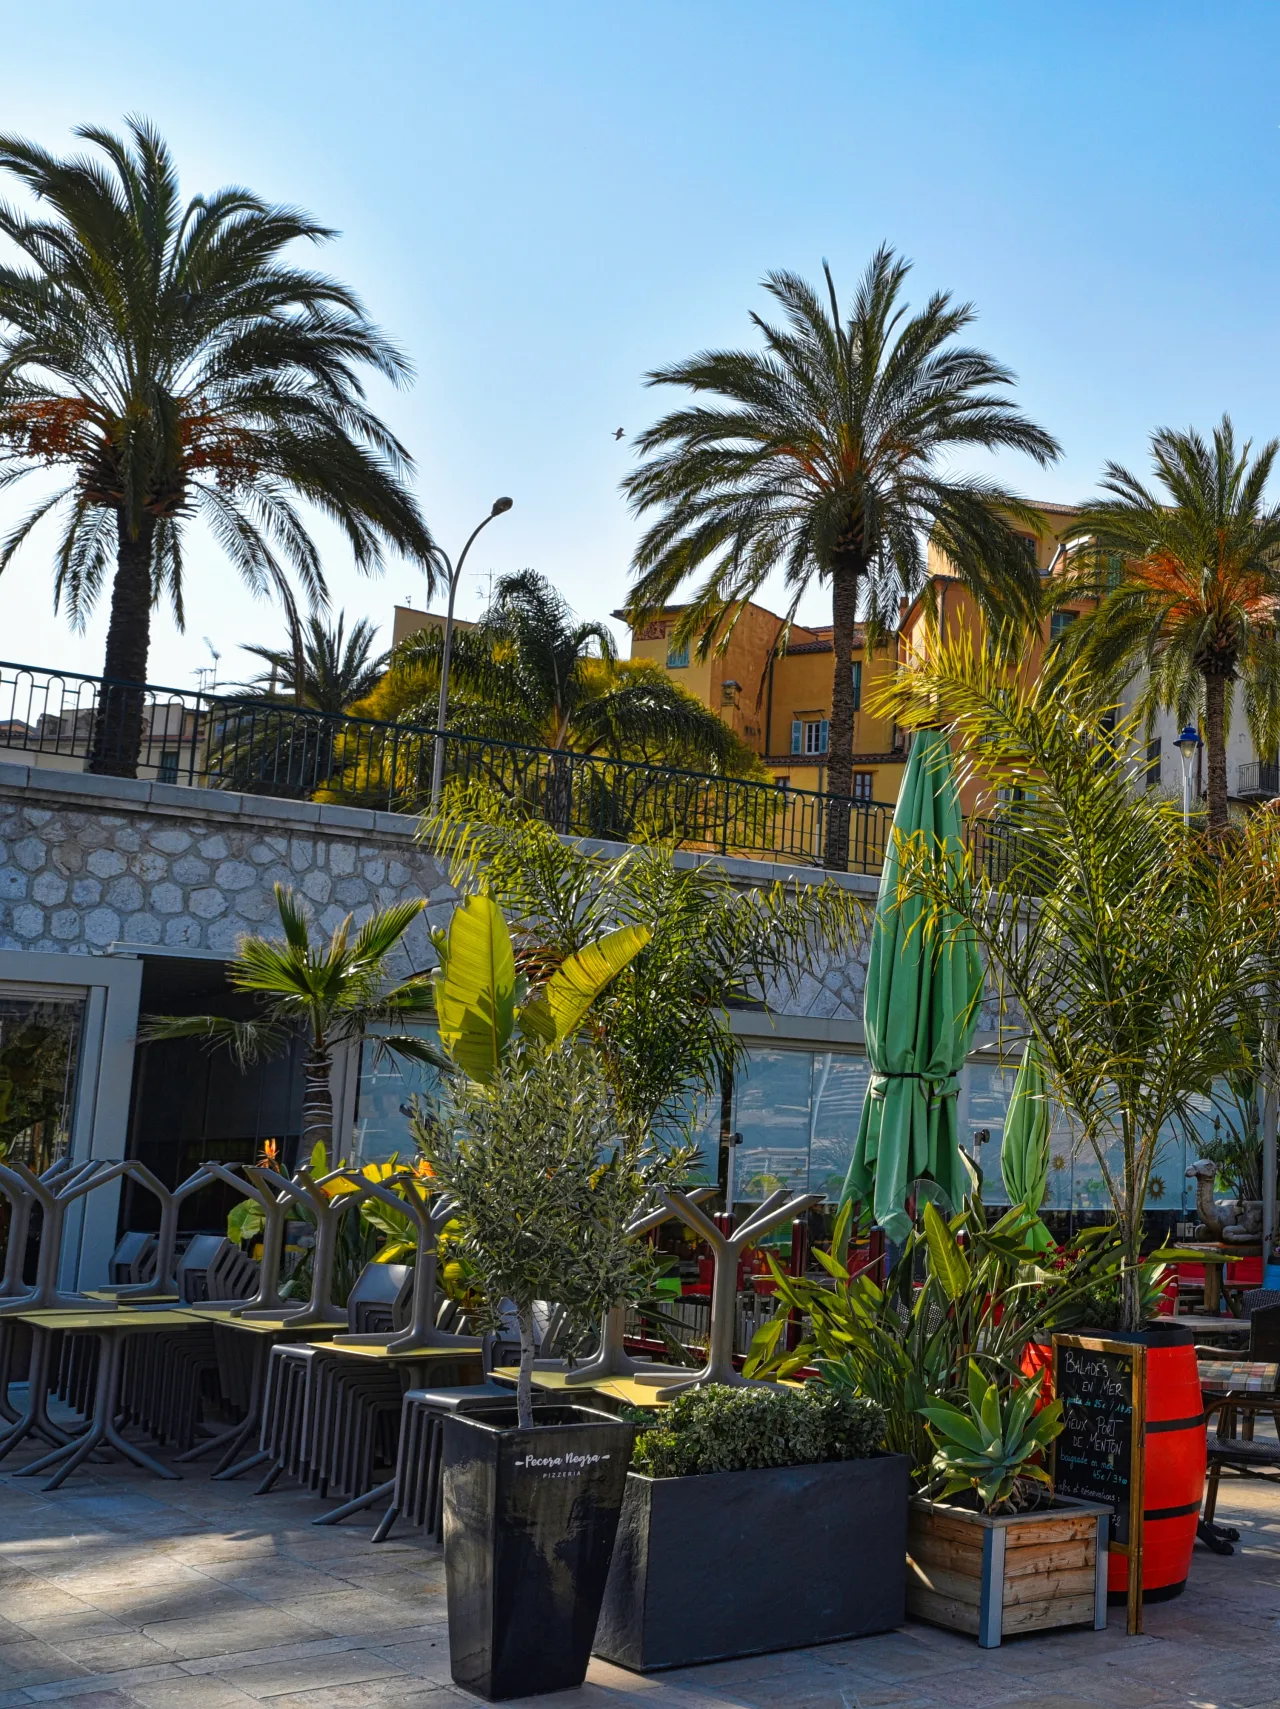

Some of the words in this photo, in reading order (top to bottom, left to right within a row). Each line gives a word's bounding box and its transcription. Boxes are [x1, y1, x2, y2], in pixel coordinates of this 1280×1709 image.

[1082, 1381, 1094, 1392] EN
[1100, 1378, 1124, 1397] MER
[1073, 1436, 1084, 1448] DE
[1087, 1432, 1123, 1456] MENTON
[525, 1454, 562, 1468] Pecora
[565, 1452, 601, 1467] Negra
[1060, 1446, 1088, 1470] baignade
[1091, 1459, 1098, 1467] en
[542, 1471, 581, 1479] PIZZERIA
[1073, 1482, 1080, 1493] et
